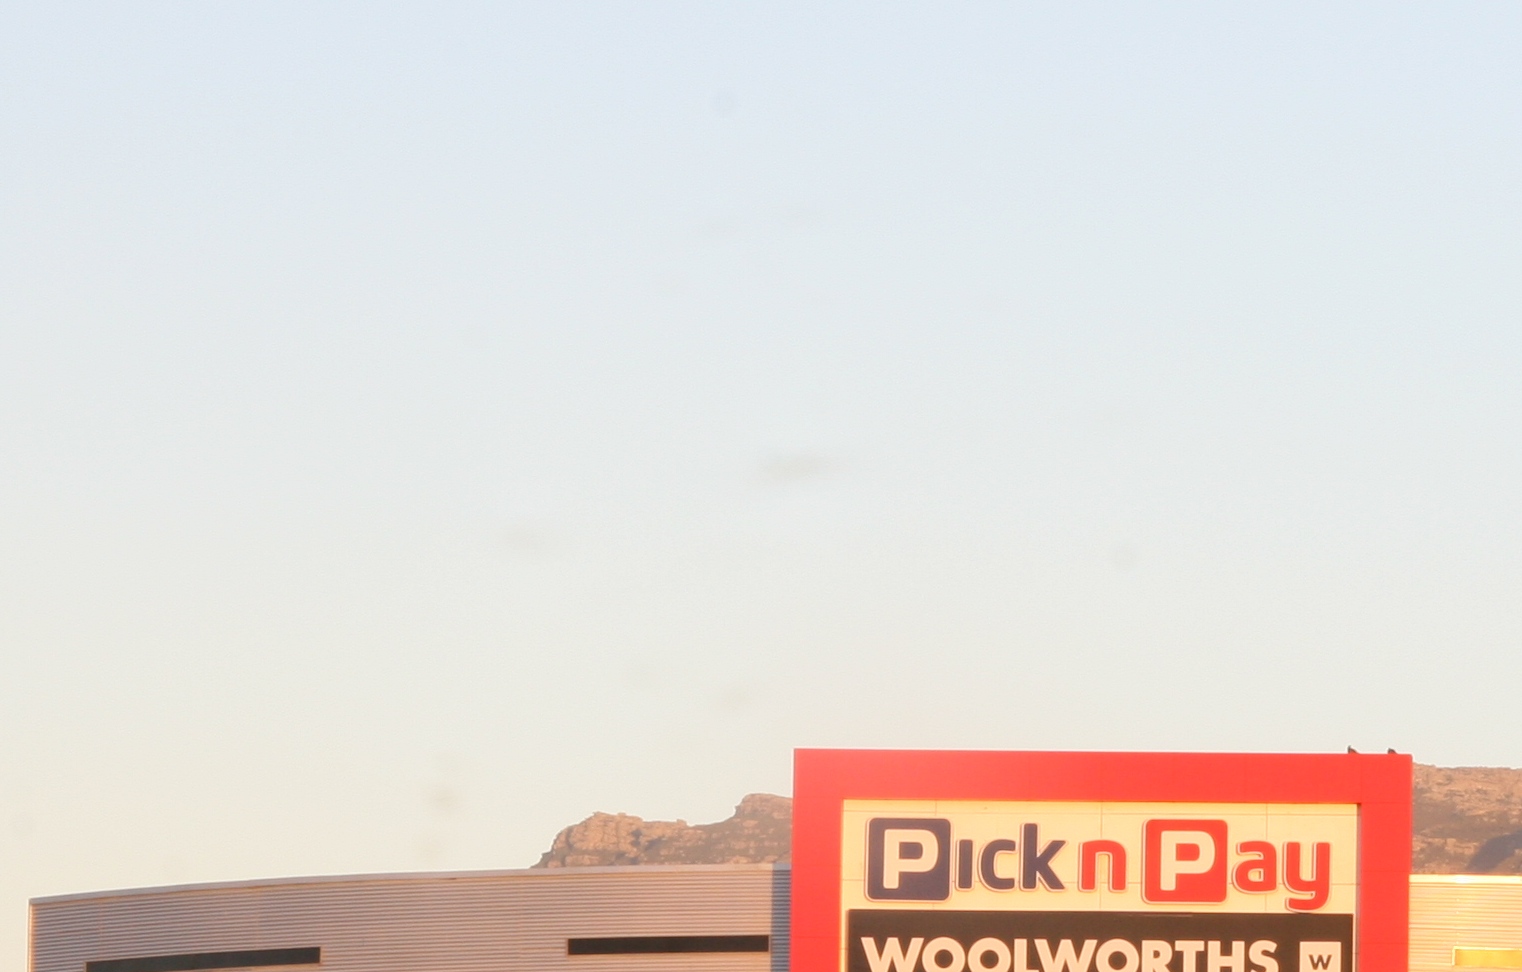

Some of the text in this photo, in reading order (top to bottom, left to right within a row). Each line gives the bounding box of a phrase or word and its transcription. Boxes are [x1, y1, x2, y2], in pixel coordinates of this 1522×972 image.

[880, 821, 1332, 912] Pick n Pay
